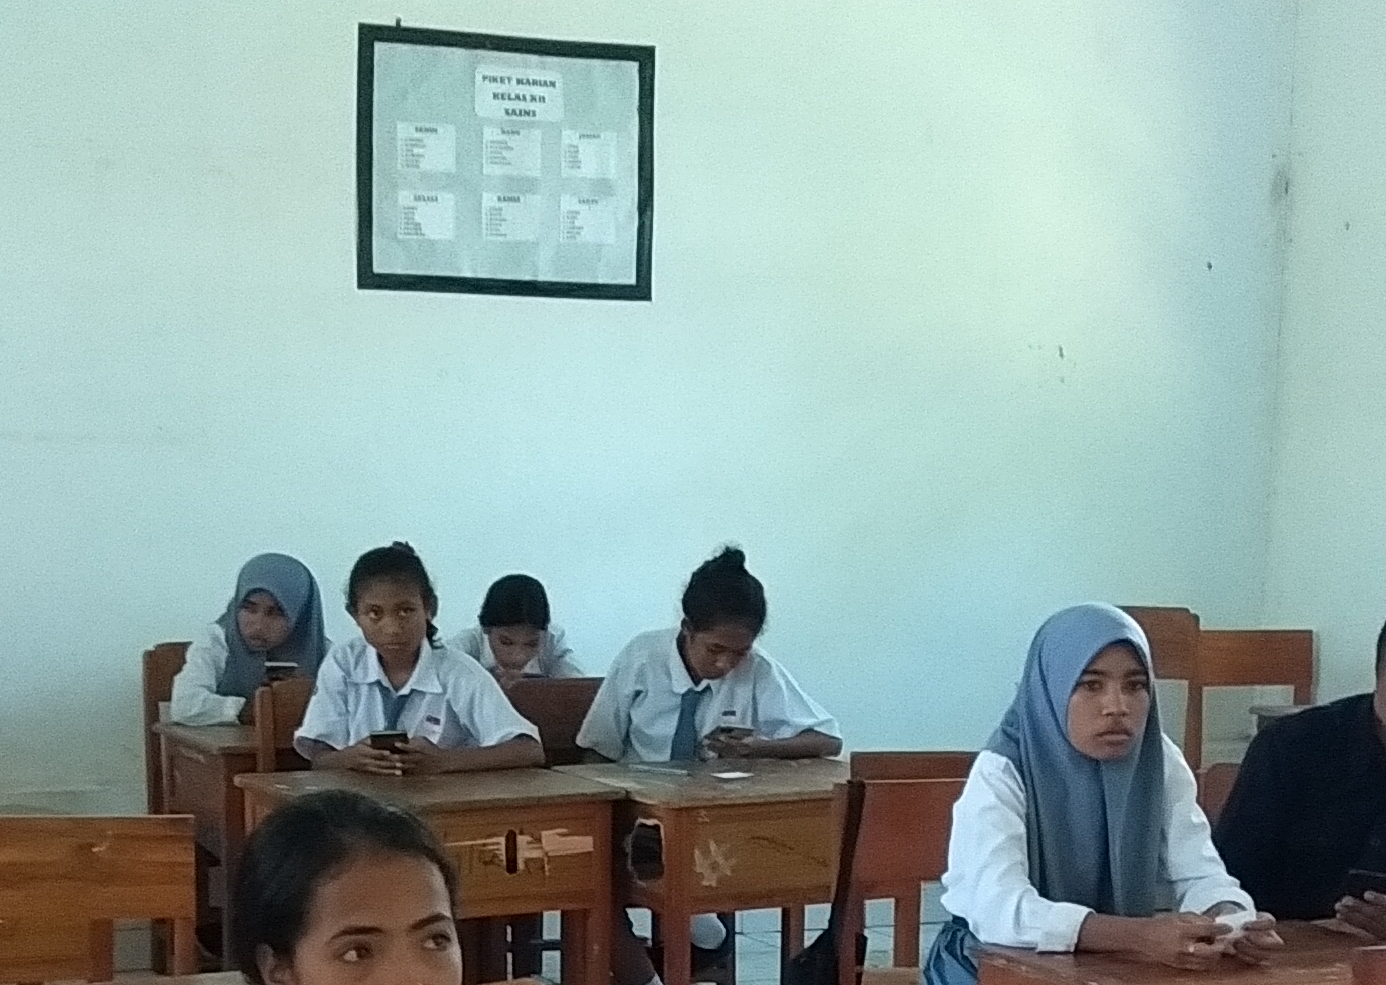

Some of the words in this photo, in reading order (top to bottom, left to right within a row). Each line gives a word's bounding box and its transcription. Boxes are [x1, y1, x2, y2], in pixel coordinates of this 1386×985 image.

[481, 74, 512, 85] PIKET
[492, 91, 527, 102] KELAS
[504, 107, 537, 117] SAINS
